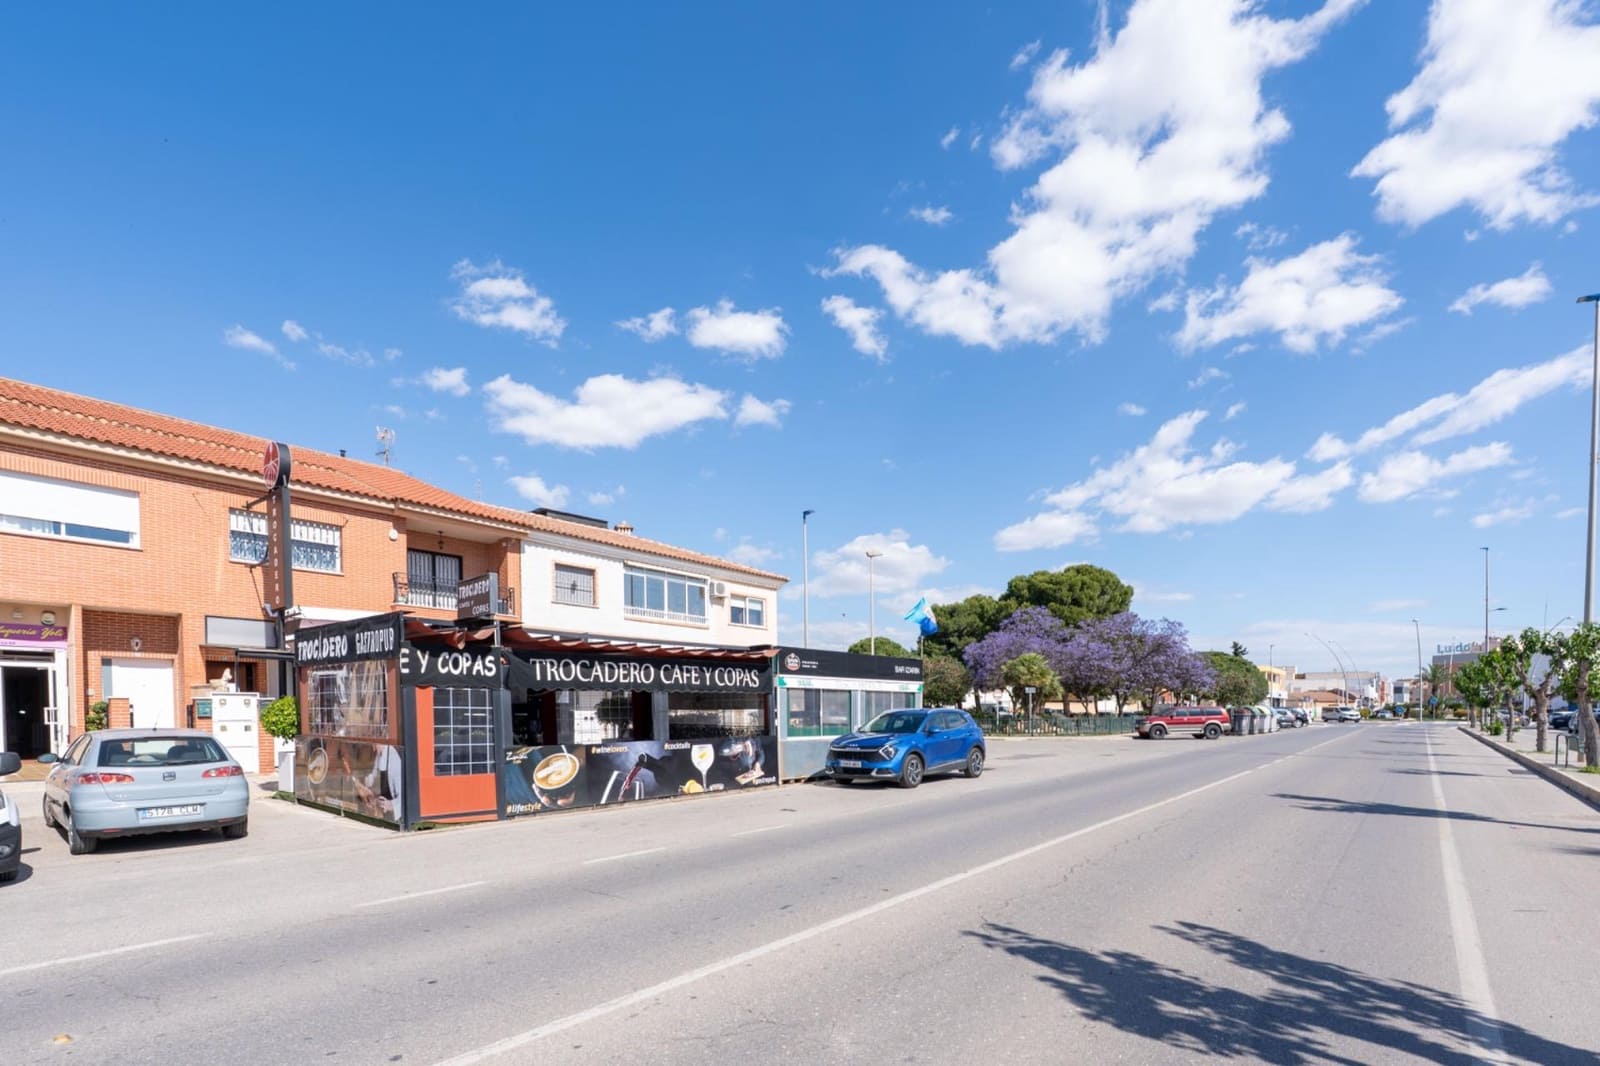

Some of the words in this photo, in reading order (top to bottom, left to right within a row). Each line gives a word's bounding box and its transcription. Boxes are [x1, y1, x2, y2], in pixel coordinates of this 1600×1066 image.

[271, 495, 280, 605] TROCADERO
[459, 579, 489, 600] TROCADERO
[472, 603, 489, 616] COPAS
[298, 631, 348, 661] TROCADERO
[356, 628, 394, 654] GASTROPUB
[416, 649, 429, 674] Y
[438, 652, 496, 677] COPAS
[530, 659, 654, 684] TROCADERO
[660, 664, 700, 685] CAFE
[703, 667, 712, 686] Y
[715, 668, 759, 688] COPAS
[591, 745, 628, 755] #winelovers
[506, 802, 542, 814] #lifestyle
